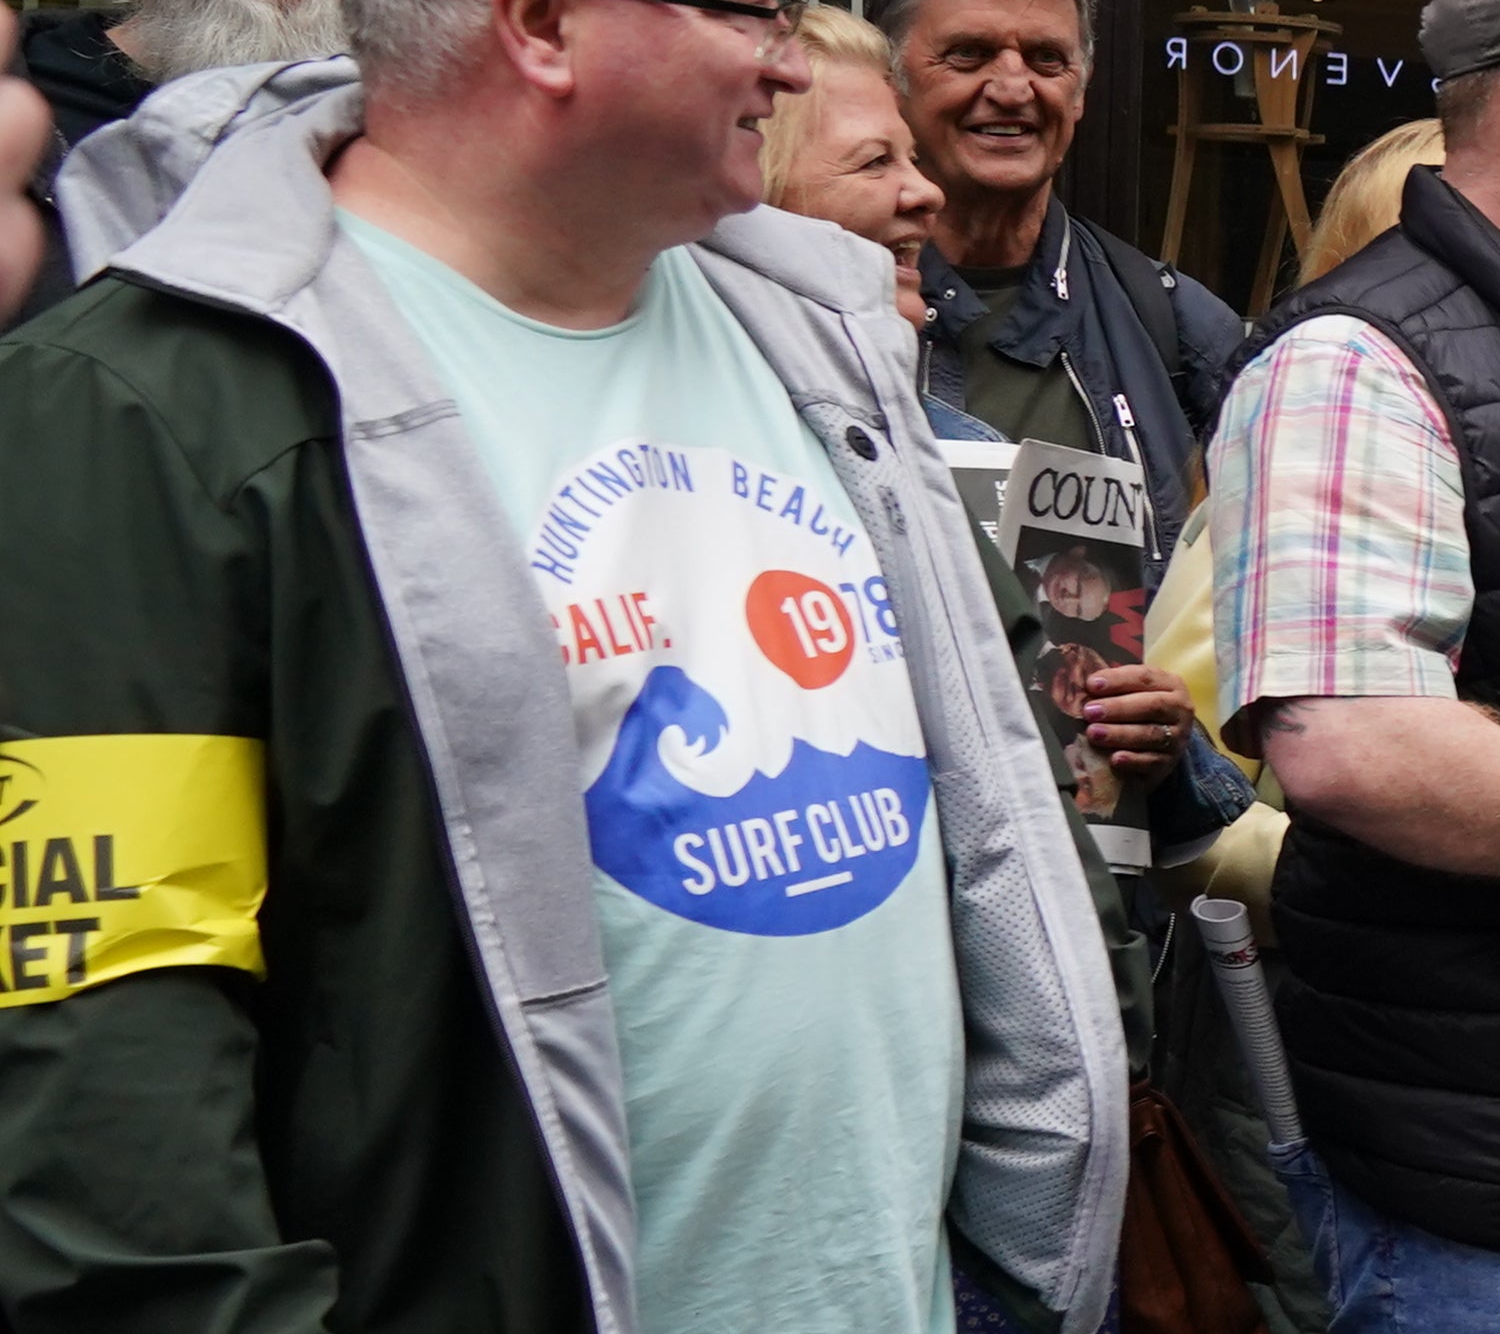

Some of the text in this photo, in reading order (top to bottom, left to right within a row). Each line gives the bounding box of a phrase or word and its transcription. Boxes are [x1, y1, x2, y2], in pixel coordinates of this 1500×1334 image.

[532, 443, 695, 585] HUNTINGTON
[731, 460, 856, 557] BEACH
[673, 787, 911, 895] SURF CLUB
